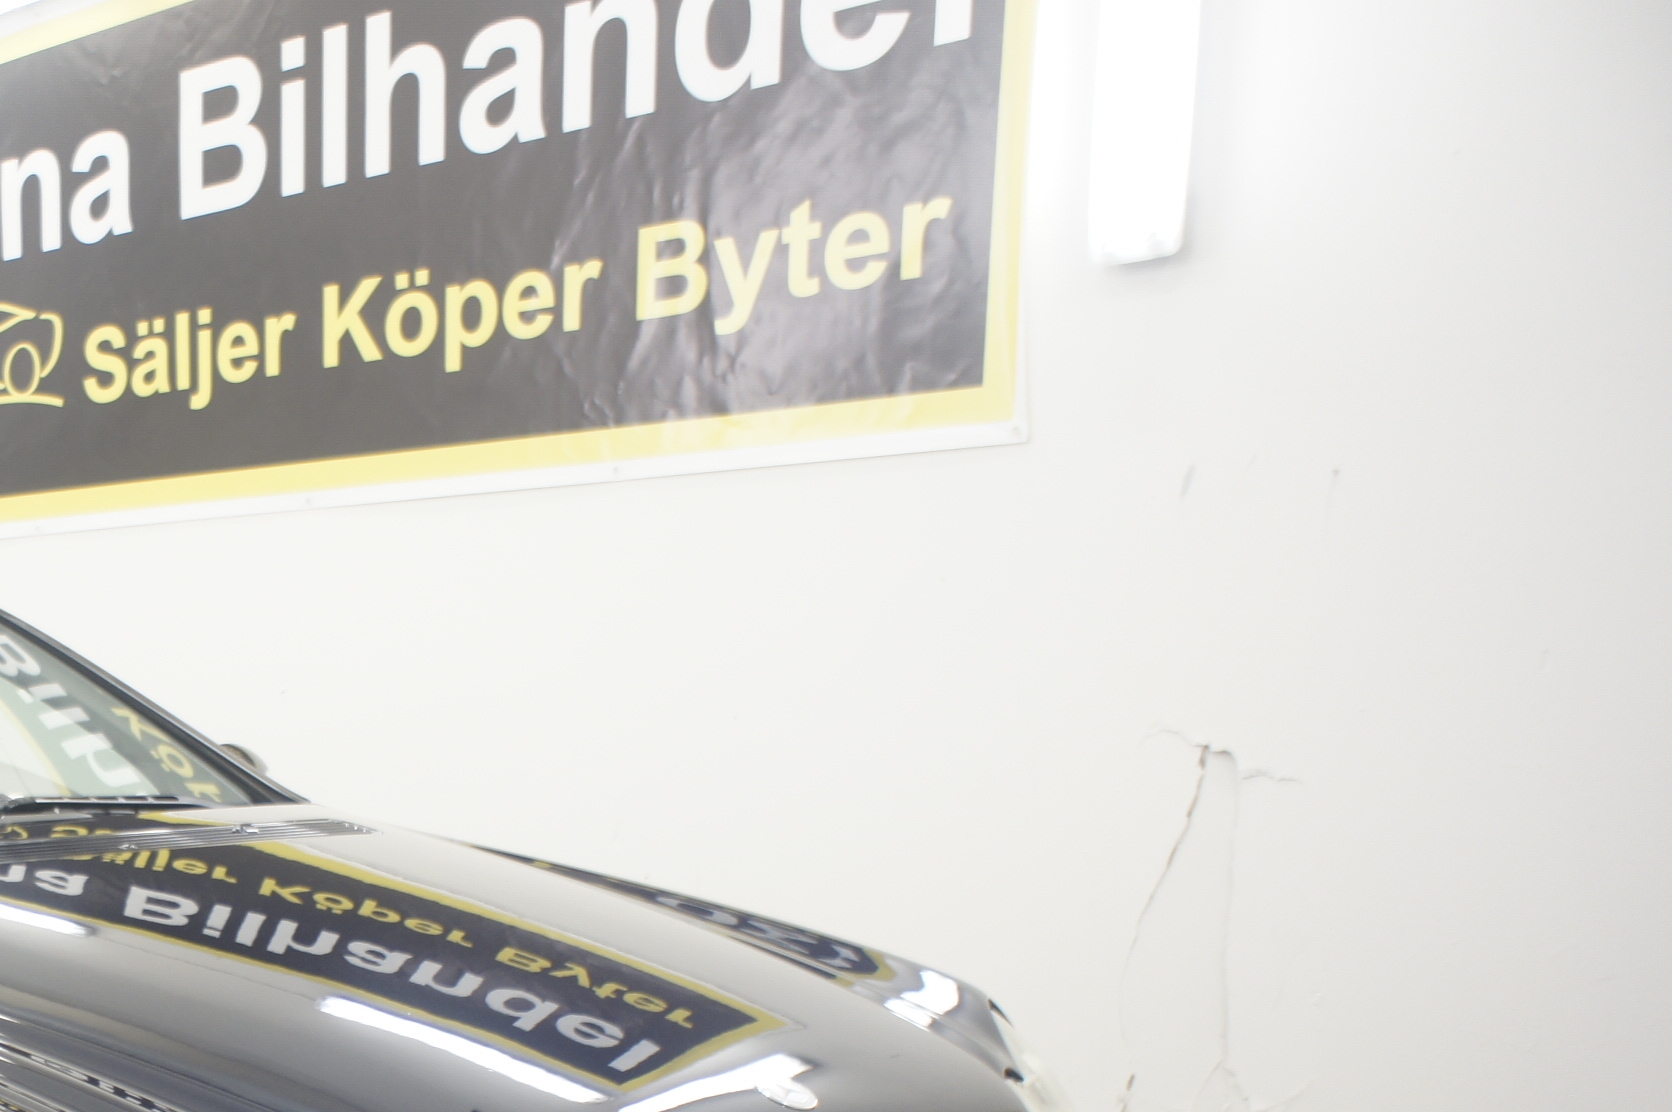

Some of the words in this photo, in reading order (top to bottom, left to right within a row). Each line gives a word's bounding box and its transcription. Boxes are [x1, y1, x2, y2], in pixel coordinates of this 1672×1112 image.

[178, 0, 973, 221] Bilhande
[83, 307, 297, 410] Säljer
[322, 259, 603, 373] Köper
[636, 196, 952, 336] Byter
